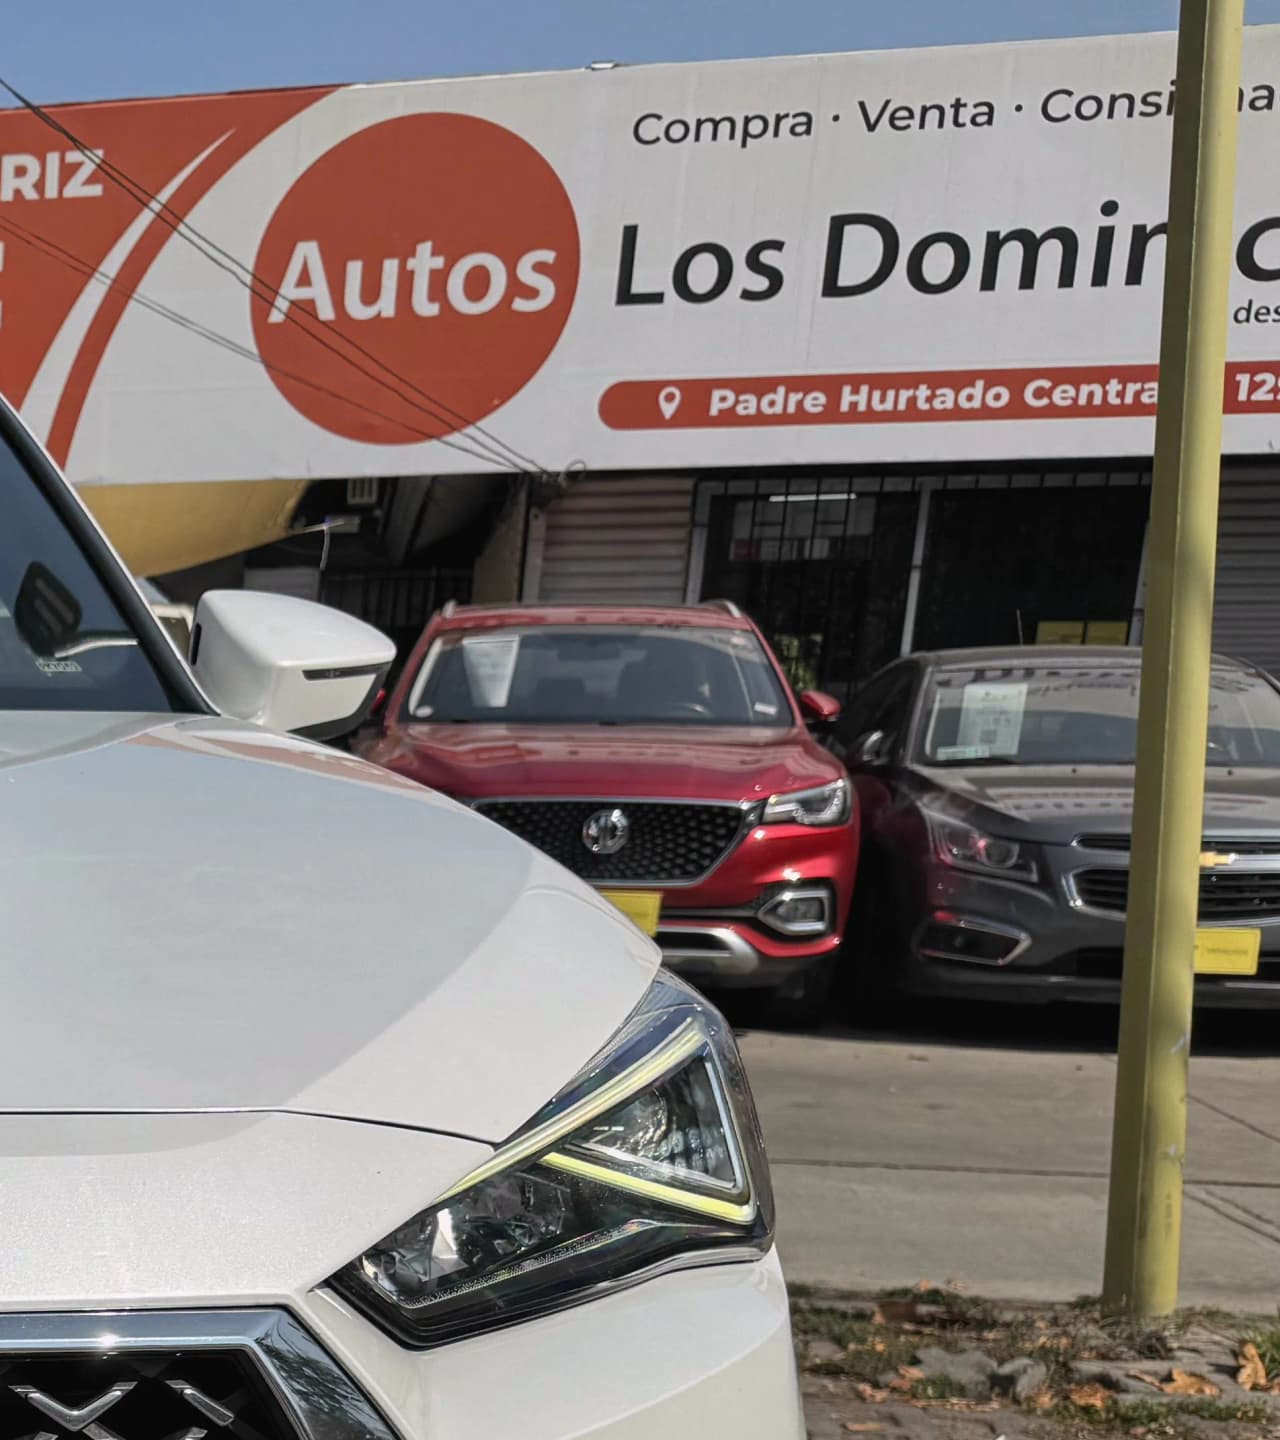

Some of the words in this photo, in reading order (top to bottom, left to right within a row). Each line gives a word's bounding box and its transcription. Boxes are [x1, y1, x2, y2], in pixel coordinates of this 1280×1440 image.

[633, 111, 813, 149] Compra
[858, 97, 995, 134] Venta
[267, 237, 558, 325] Autos
[614, 223, 786, 307] Los
[708, 384, 827, 418] Padre
[839, 375, 1010, 413] Hurtado
[1023, 377, 1159, 408] Centra
[1235, 372, 1280, 402] 12
